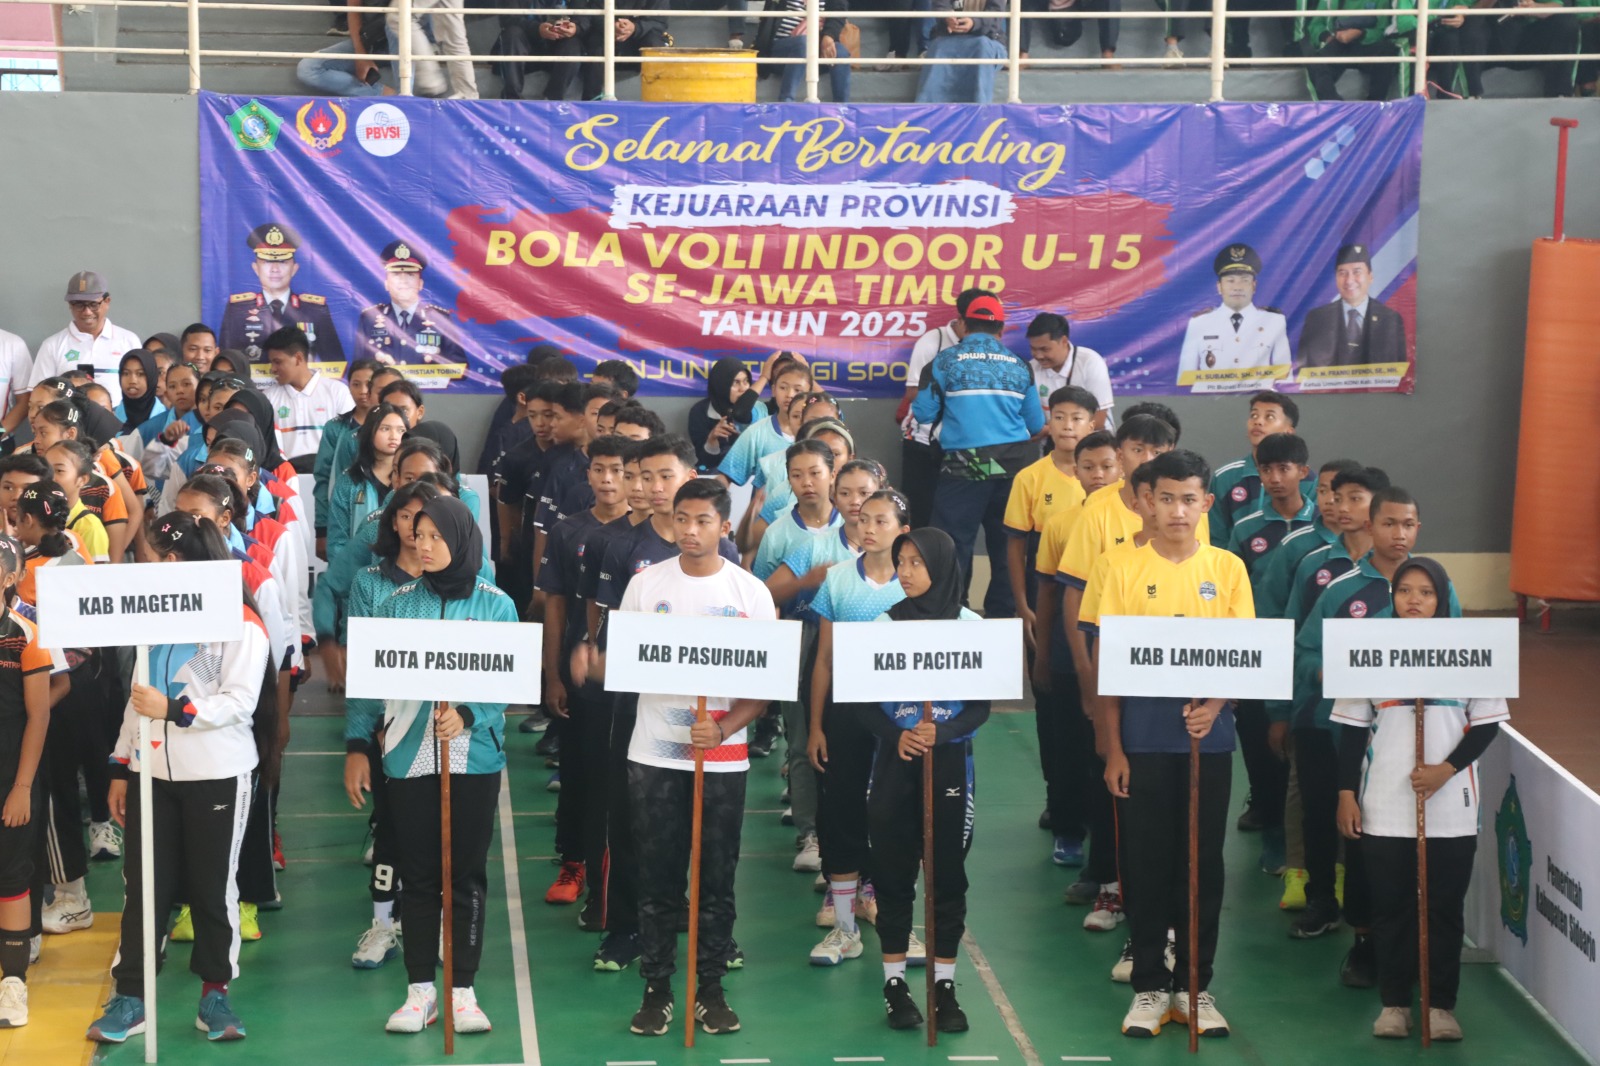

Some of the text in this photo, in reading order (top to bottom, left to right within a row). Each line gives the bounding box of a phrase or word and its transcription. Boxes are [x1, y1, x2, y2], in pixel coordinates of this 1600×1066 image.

[365, 126, 400, 139] PBVSI
[565, 113, 1066, 191] Selamat Bertanding
[630, 193, 1000, 218] KEJUARAAN PROVINSI
[485, 230, 1142, 270] BOLA VOLI INDOOR U-15
[624, 272, 838, 305] SE-JAWA
[698, 310, 928, 338] TAHUN 2025
[957, 352, 1017, 364] JAWA TIMUR
[78, 593, 203, 616] KAB MAGETAN
[374, 649, 514, 672] KOTA PASURUAN
[639, 643, 768, 669] KAB PASURUAN
[874, 651, 982, 671] KAB PACITAN
[1130, 647, 1262, 668] KAB LAMONGAN
[1349, 648, 1492, 668] KAB PAMEKASAN
[374, 863, 394, 892] 9
[1547, 855, 1583, 912] Pemerintah
[1536, 883, 1596, 963] Kabupaten Sidoarjo
